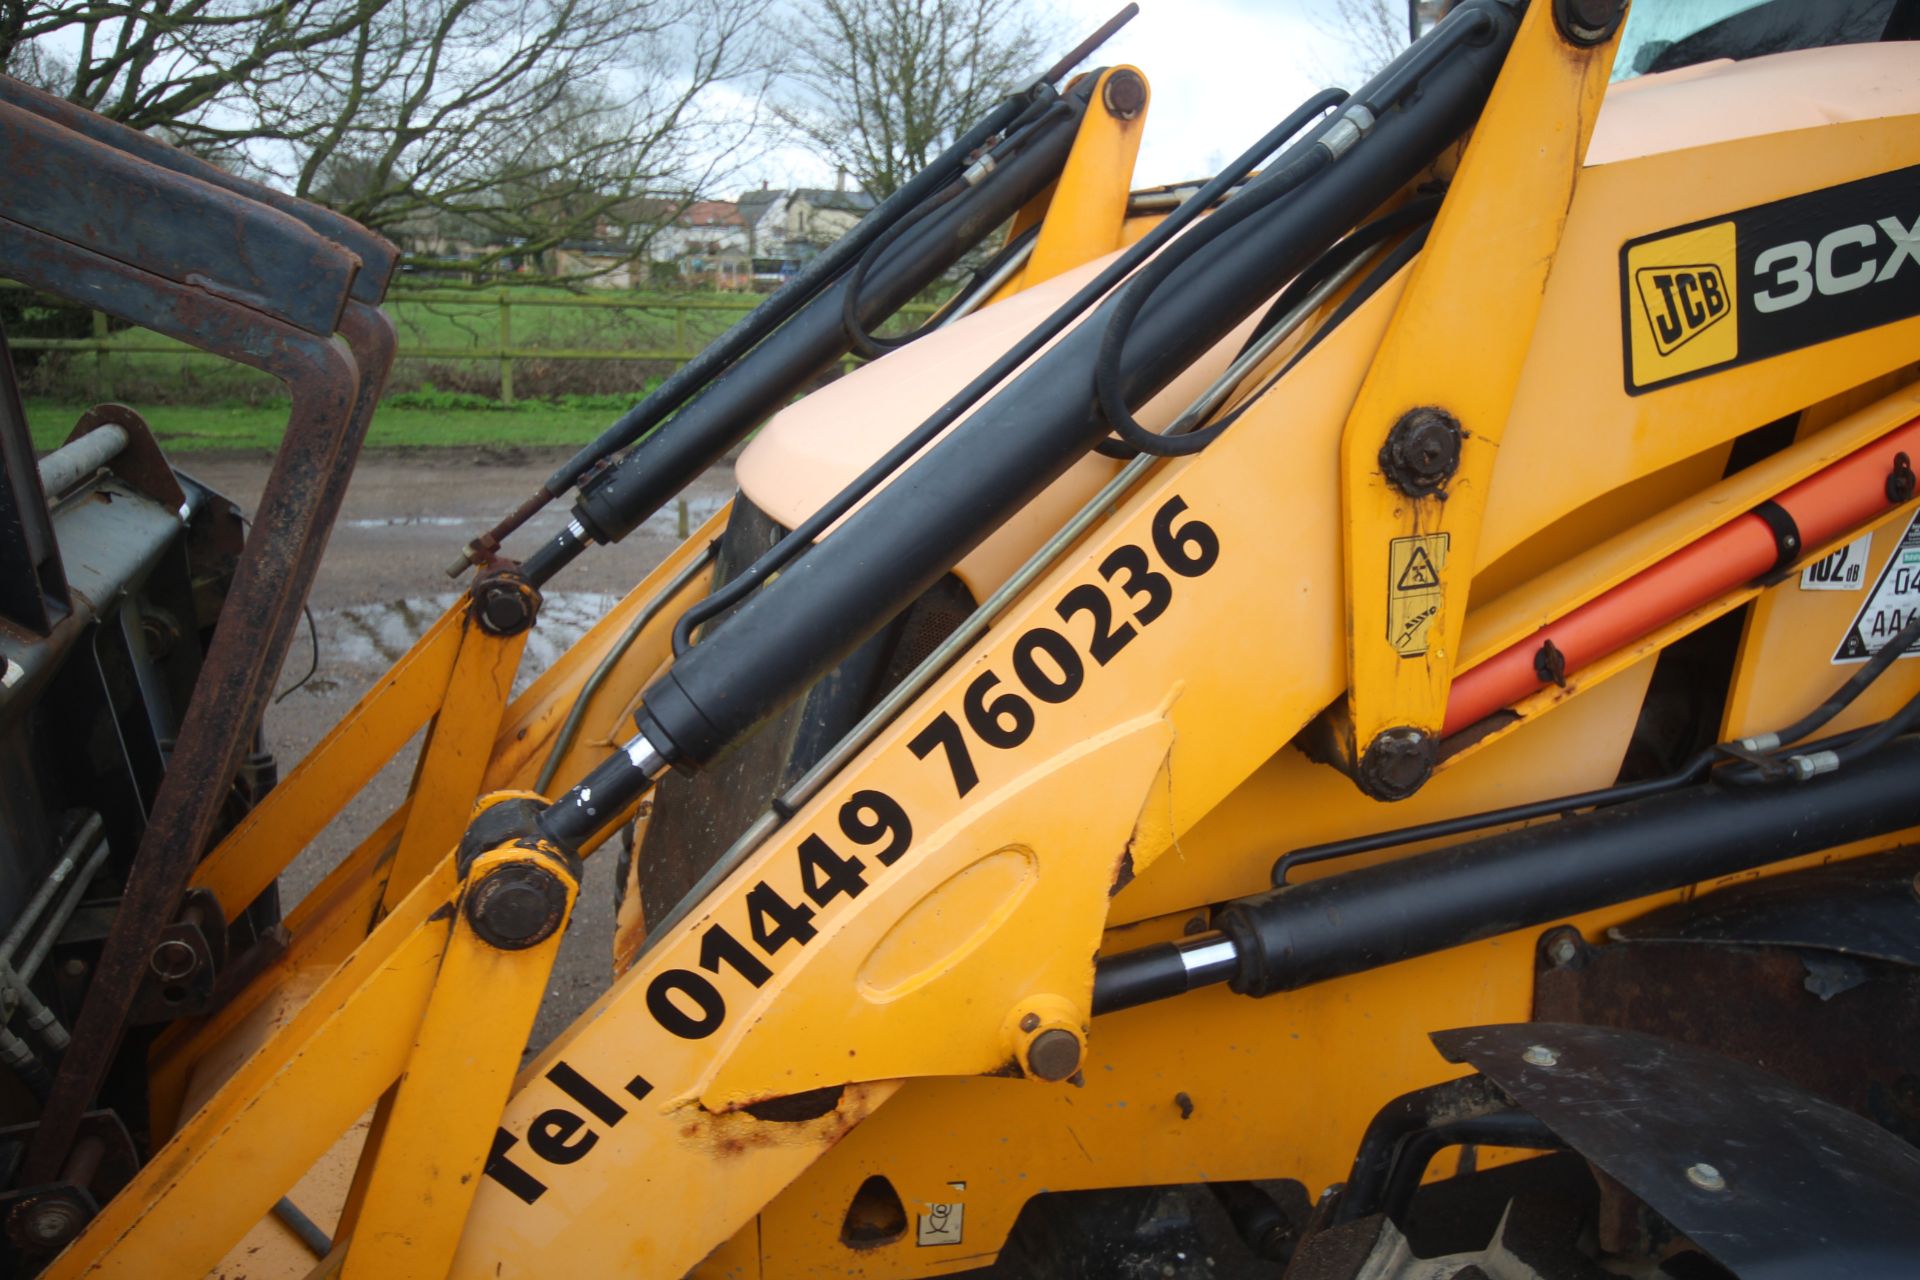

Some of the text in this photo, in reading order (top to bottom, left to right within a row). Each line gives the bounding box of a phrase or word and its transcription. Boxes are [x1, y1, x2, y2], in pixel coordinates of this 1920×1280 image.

[1753, 215, 1920, 314] 3CX
[1653, 271, 1724, 345] JCB
[1846, 564, 1860, 582] dB
[646, 789, 914, 1040] 01449
[907, 494, 1220, 799] 760236
